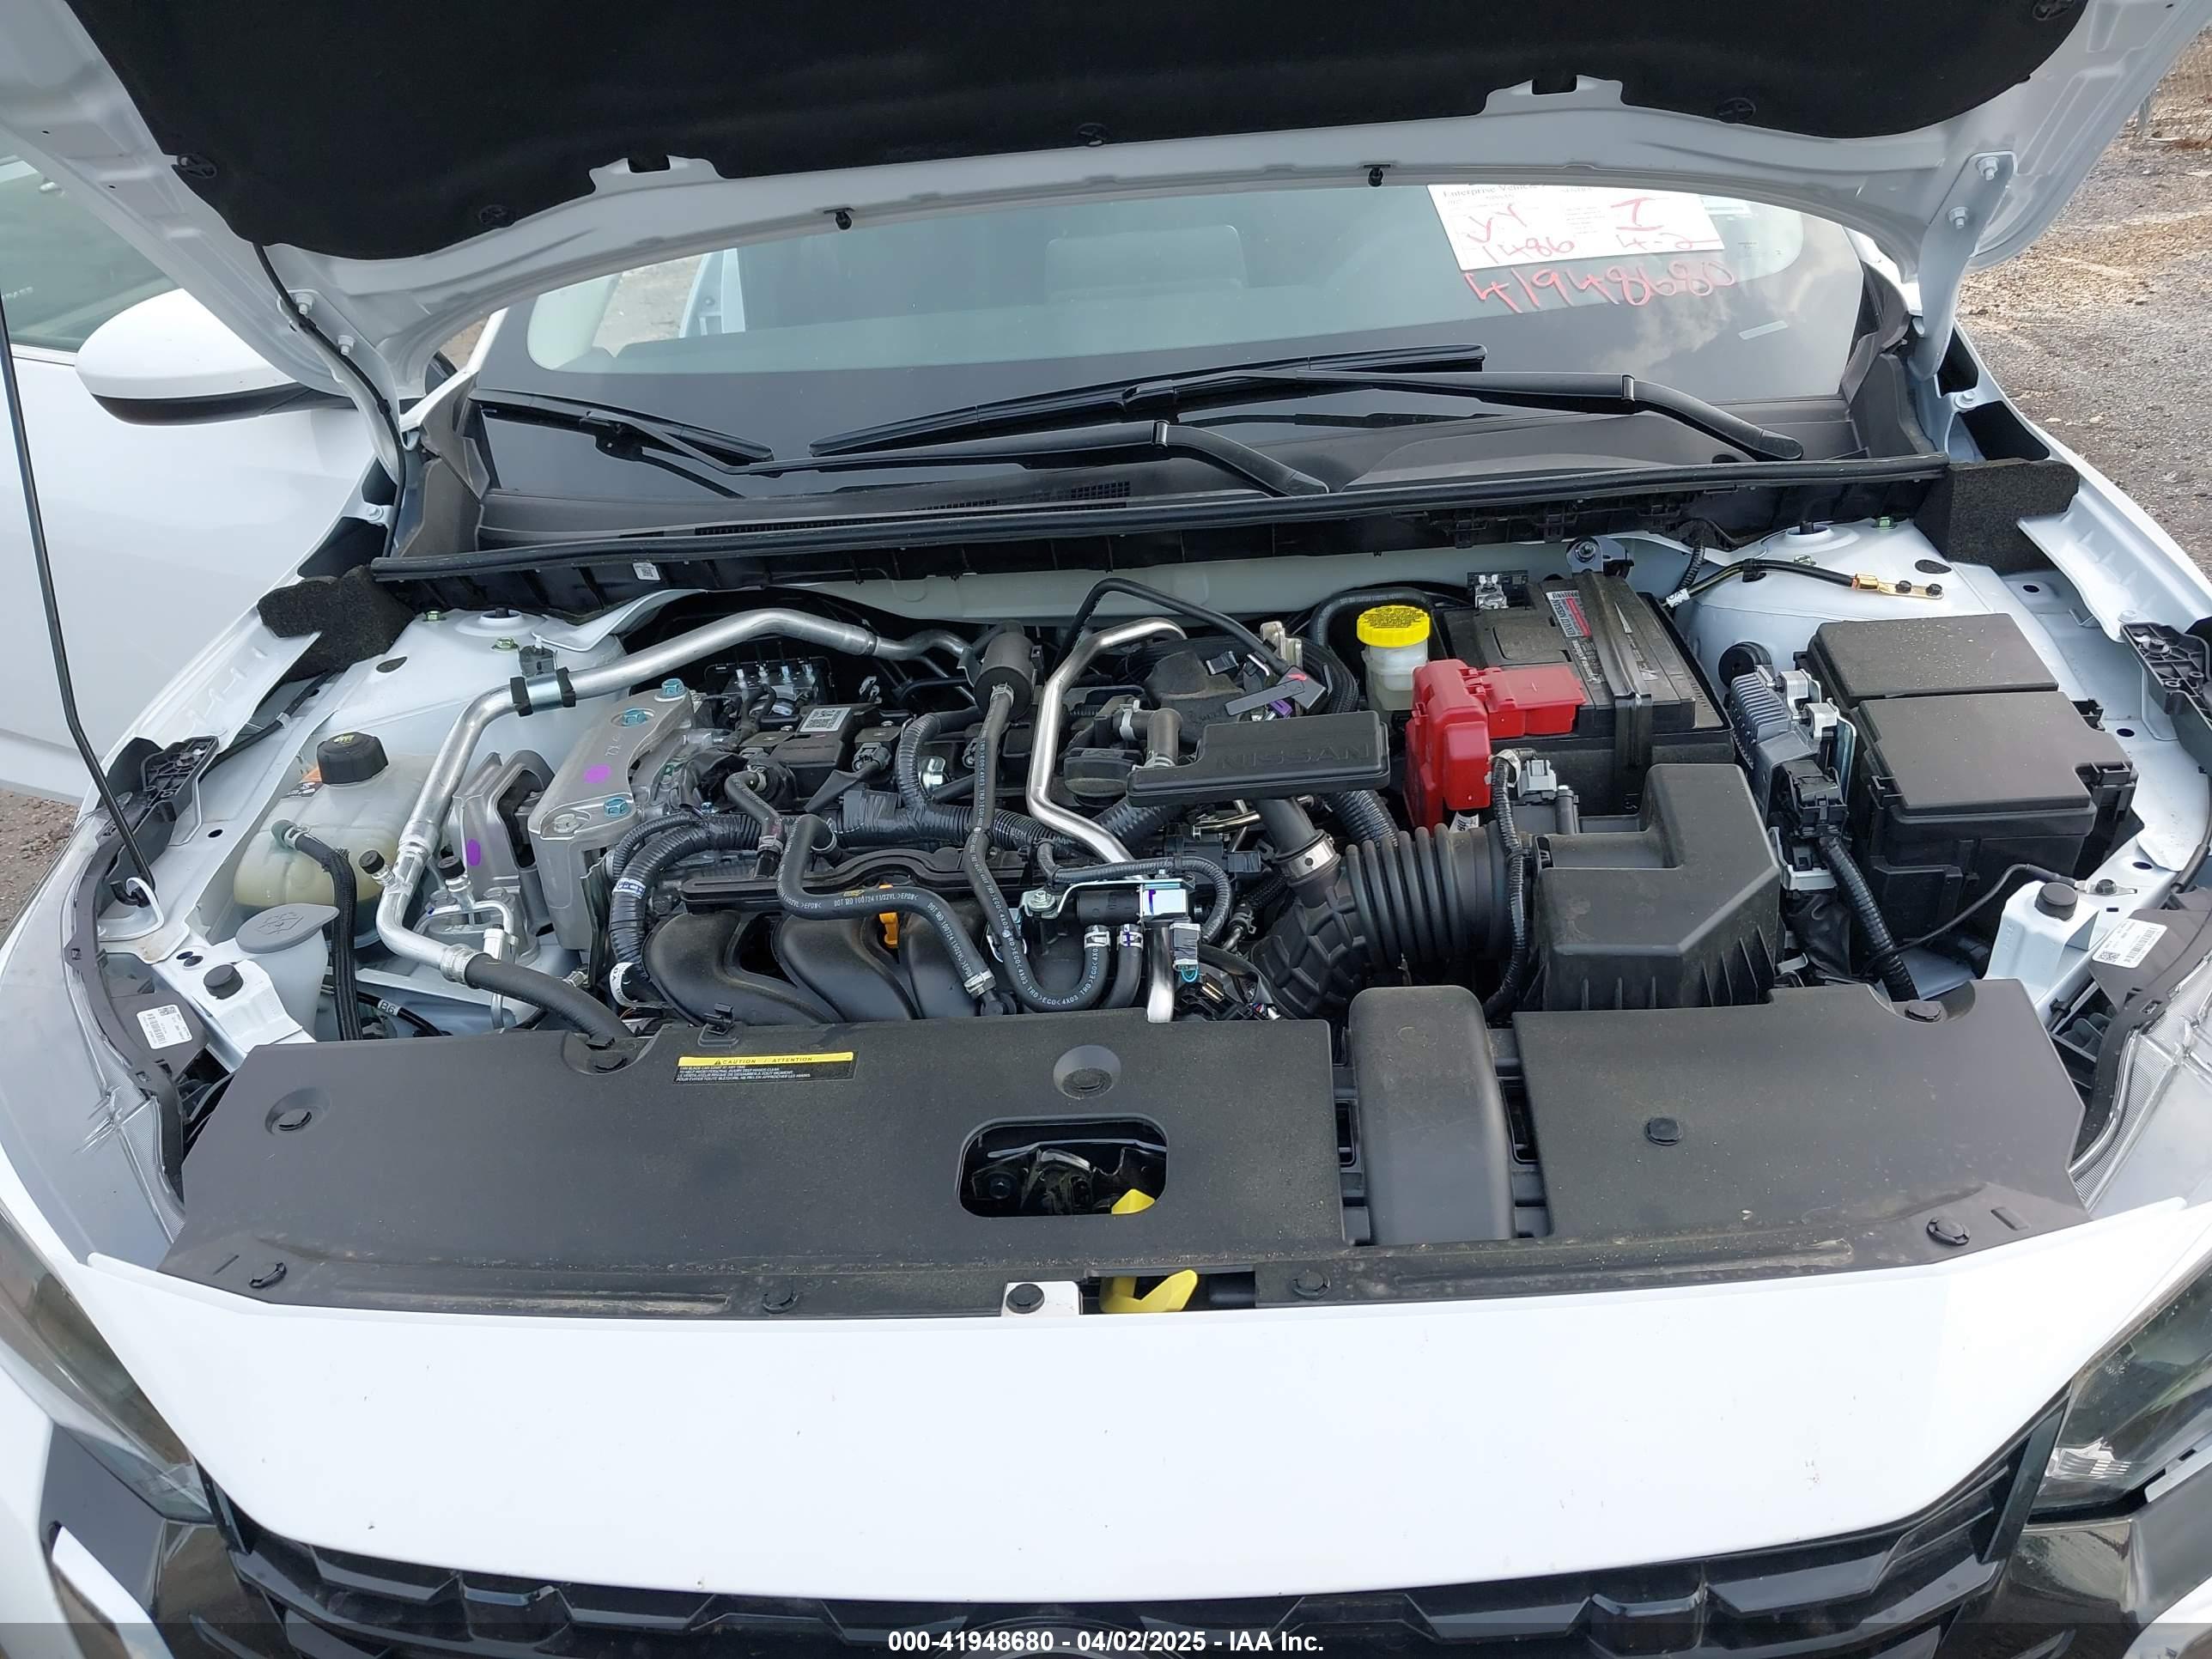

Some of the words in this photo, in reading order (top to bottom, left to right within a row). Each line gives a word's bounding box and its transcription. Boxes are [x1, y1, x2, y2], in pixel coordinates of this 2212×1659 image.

[1464, 259, 1735, 313] 41948680
[1215, 743, 1370, 769] NISSAN
[1080, 947, 1100, 996] TRD>ECO<4X0
[380, 1001, 396, 1014] B6
